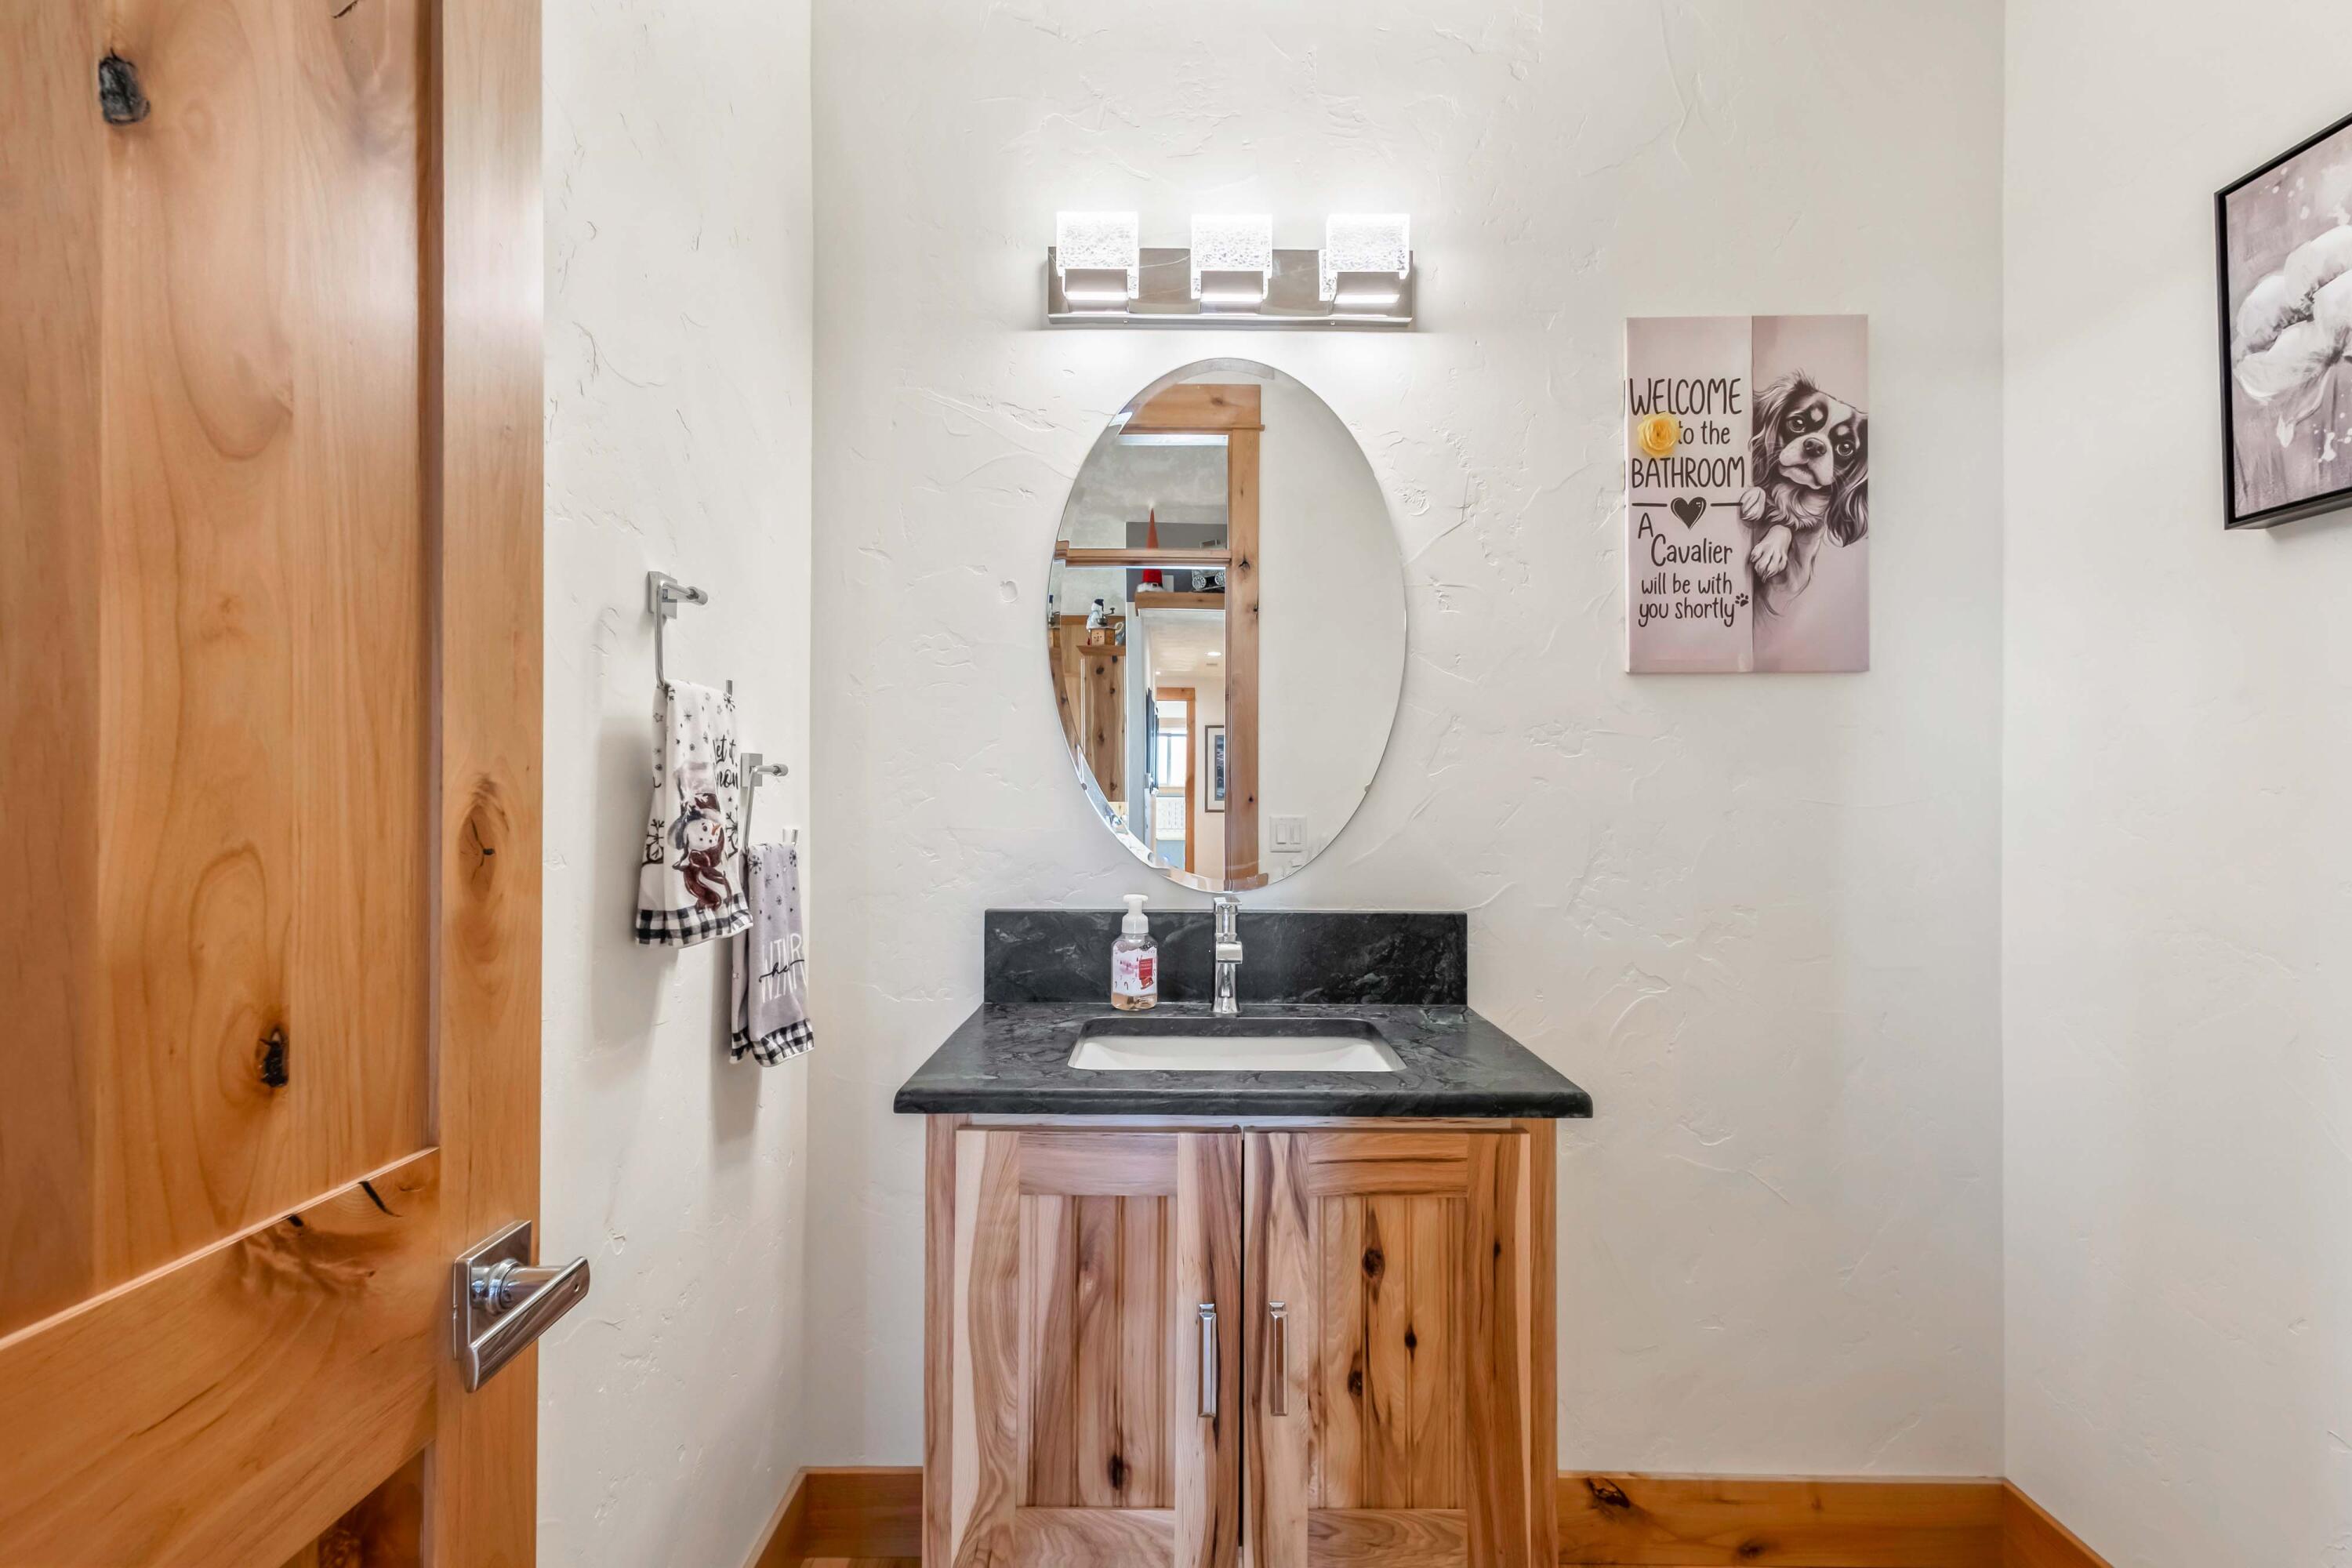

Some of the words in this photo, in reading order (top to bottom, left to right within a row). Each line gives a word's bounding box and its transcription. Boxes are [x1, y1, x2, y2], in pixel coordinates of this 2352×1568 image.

[1629, 377, 1742, 416] WELCOME
[1700, 420, 1731, 445] the
[1632, 456, 1745, 488] BATHROOM
[1638, 512, 1653, 539] A
[1650, 533, 1733, 567] Cavalier
[1641, 572, 1666, 595] will
[1672, 572, 1690, 594] be
[1698, 572, 1733, 595] with
[1638, 603, 1669, 627] you
[1675, 597, 1735, 627] shortly
